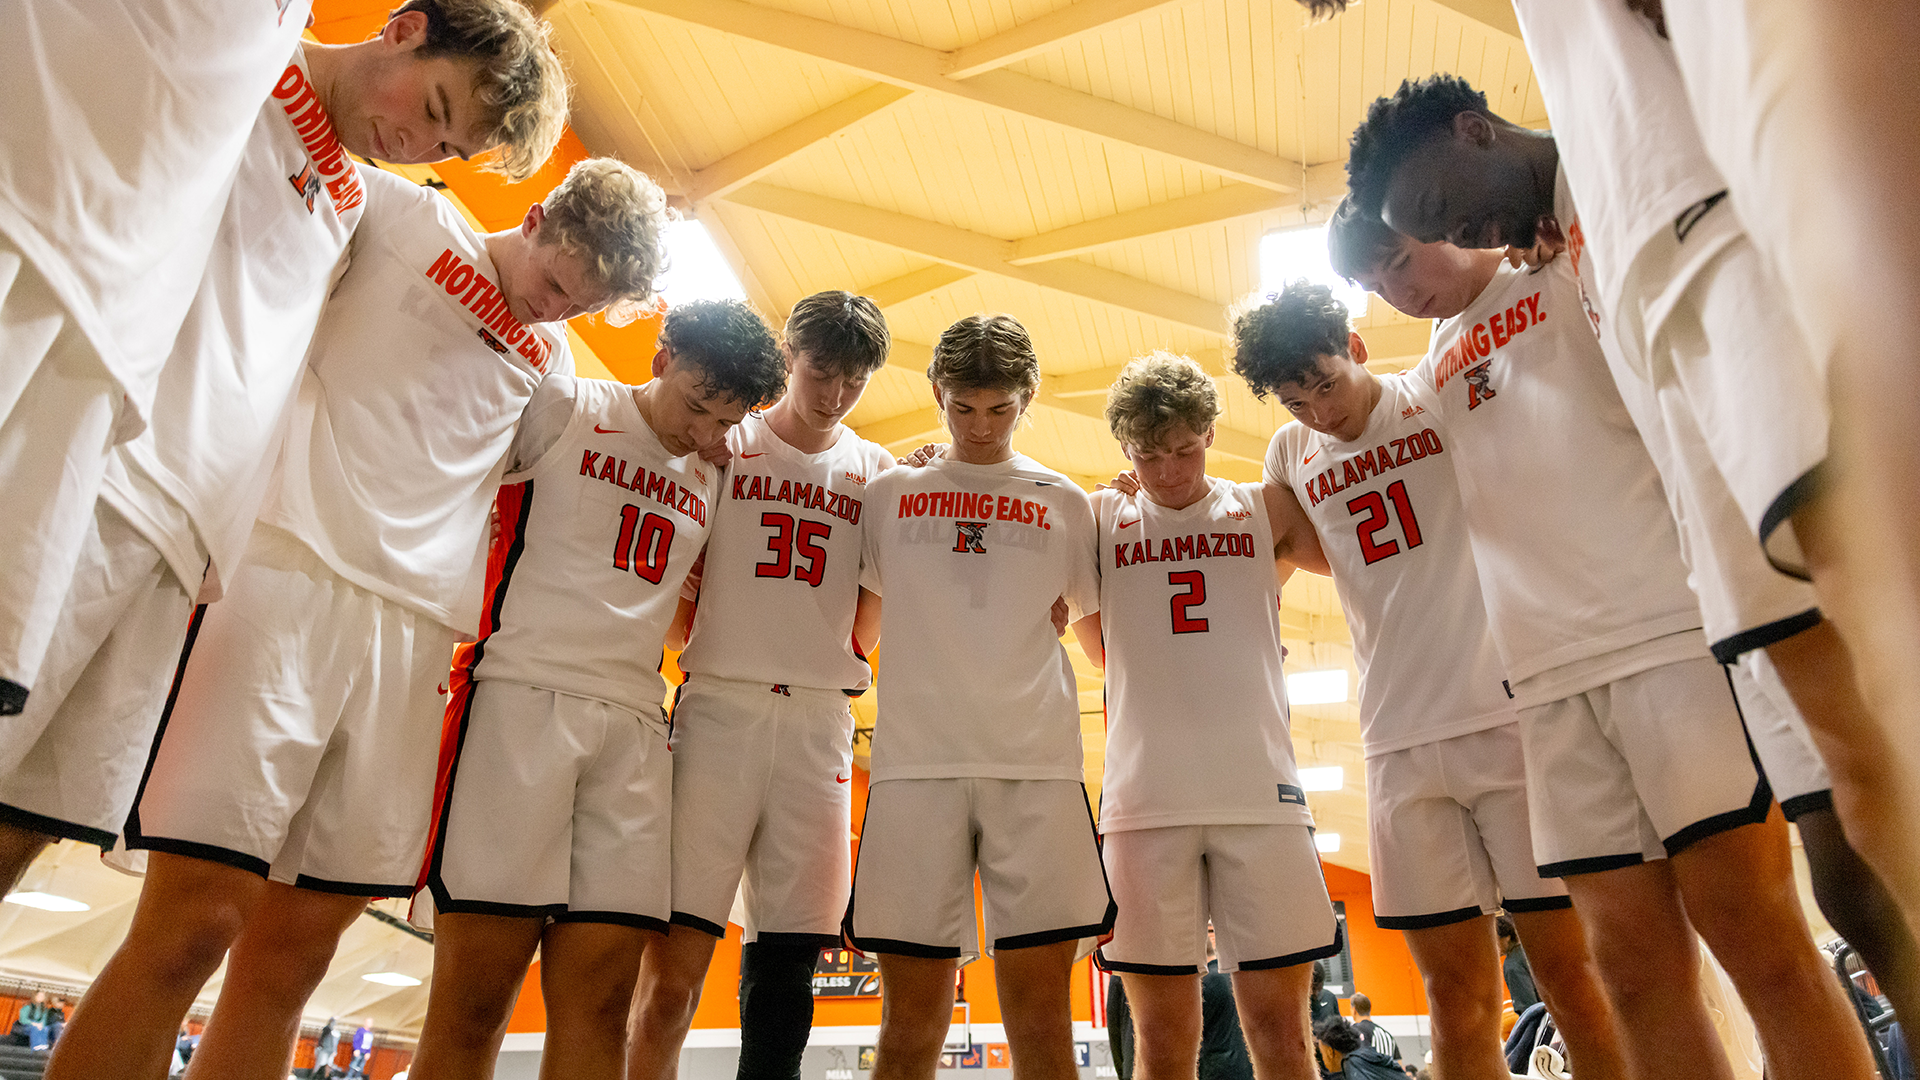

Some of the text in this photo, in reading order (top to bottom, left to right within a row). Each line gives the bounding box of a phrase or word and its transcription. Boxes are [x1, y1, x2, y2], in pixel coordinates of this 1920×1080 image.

[425, 248, 527, 346] NOTHING
[1489, 292, 1547, 349] EASY.
[579, 449, 706, 528] KALAMAZOO
[732, 475, 862, 525] KALAMAZOO
[1305, 428, 1444, 507] KALAMAZOO
[613, 503, 675, 585] 10
[898, 492, 1051, 530] NOTHING EASY.
[1346, 479, 1423, 566] 21
[755, 512, 832, 587] 35
[1115, 533, 1255, 568] KALAMAZOO
[1168, 570, 1209, 634] 2
